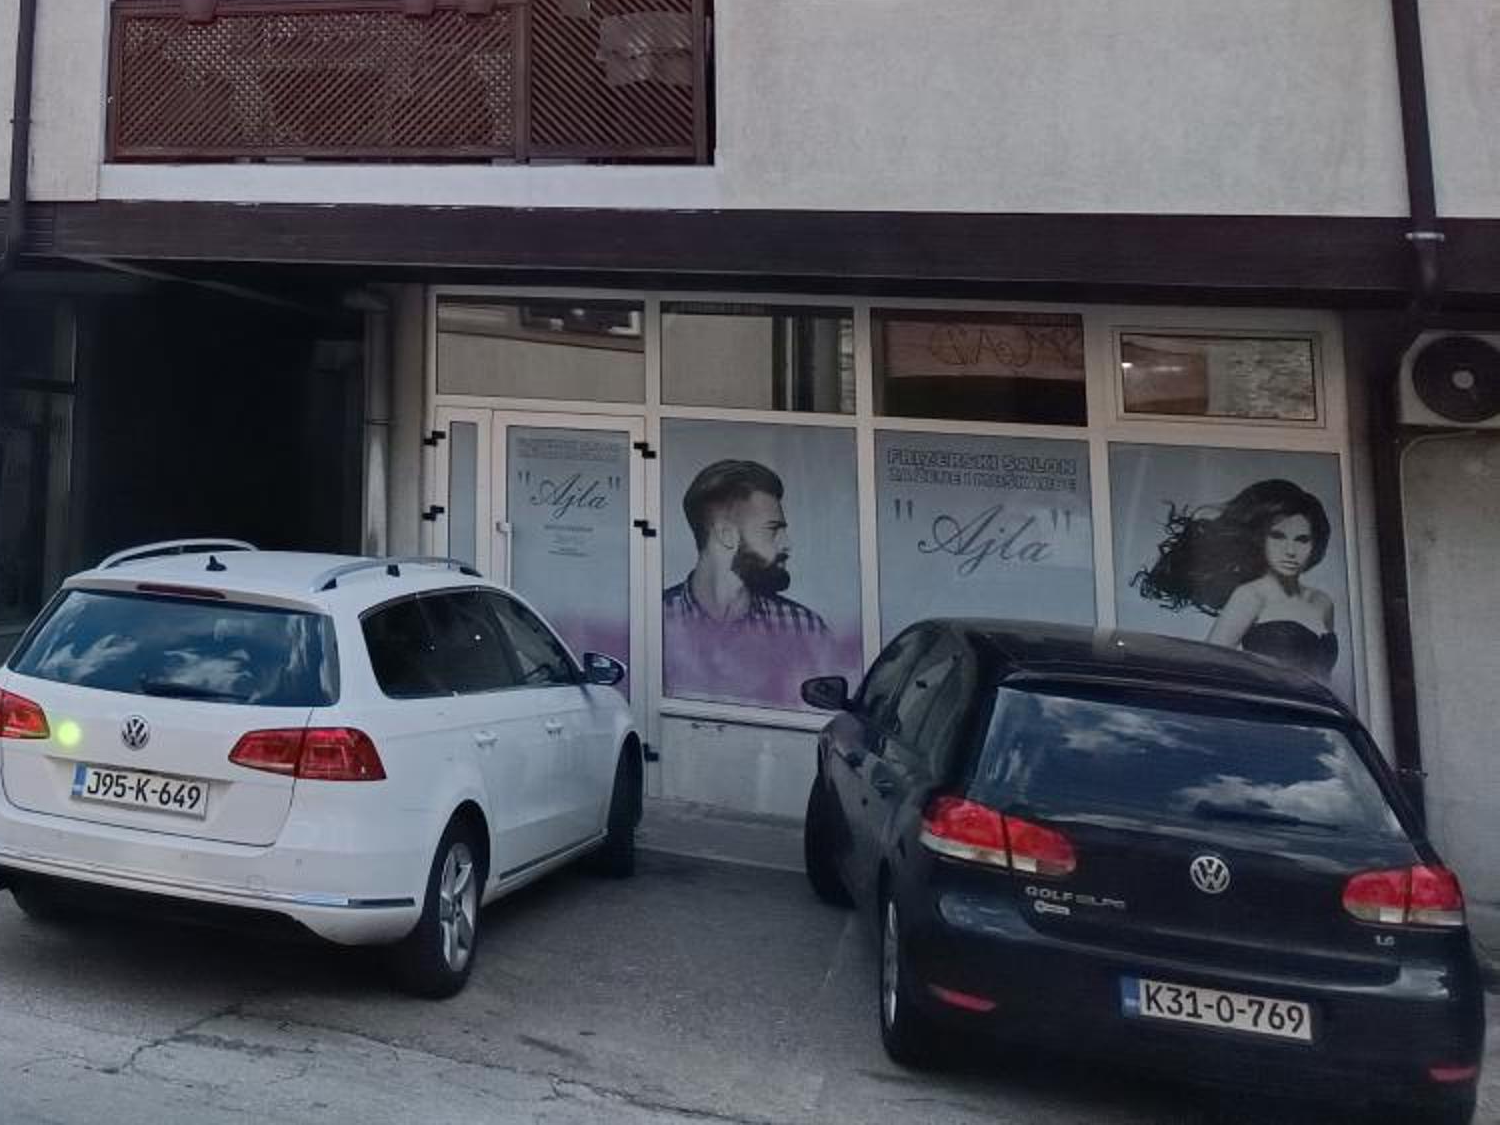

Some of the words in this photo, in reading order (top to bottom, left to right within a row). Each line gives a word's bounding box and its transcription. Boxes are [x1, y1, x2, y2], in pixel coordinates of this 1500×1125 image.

[1003, 456, 1077, 476] SALON
[87, 772, 202, 810] J95-K-649
[1025, 886, 1074, 901] GOLF
